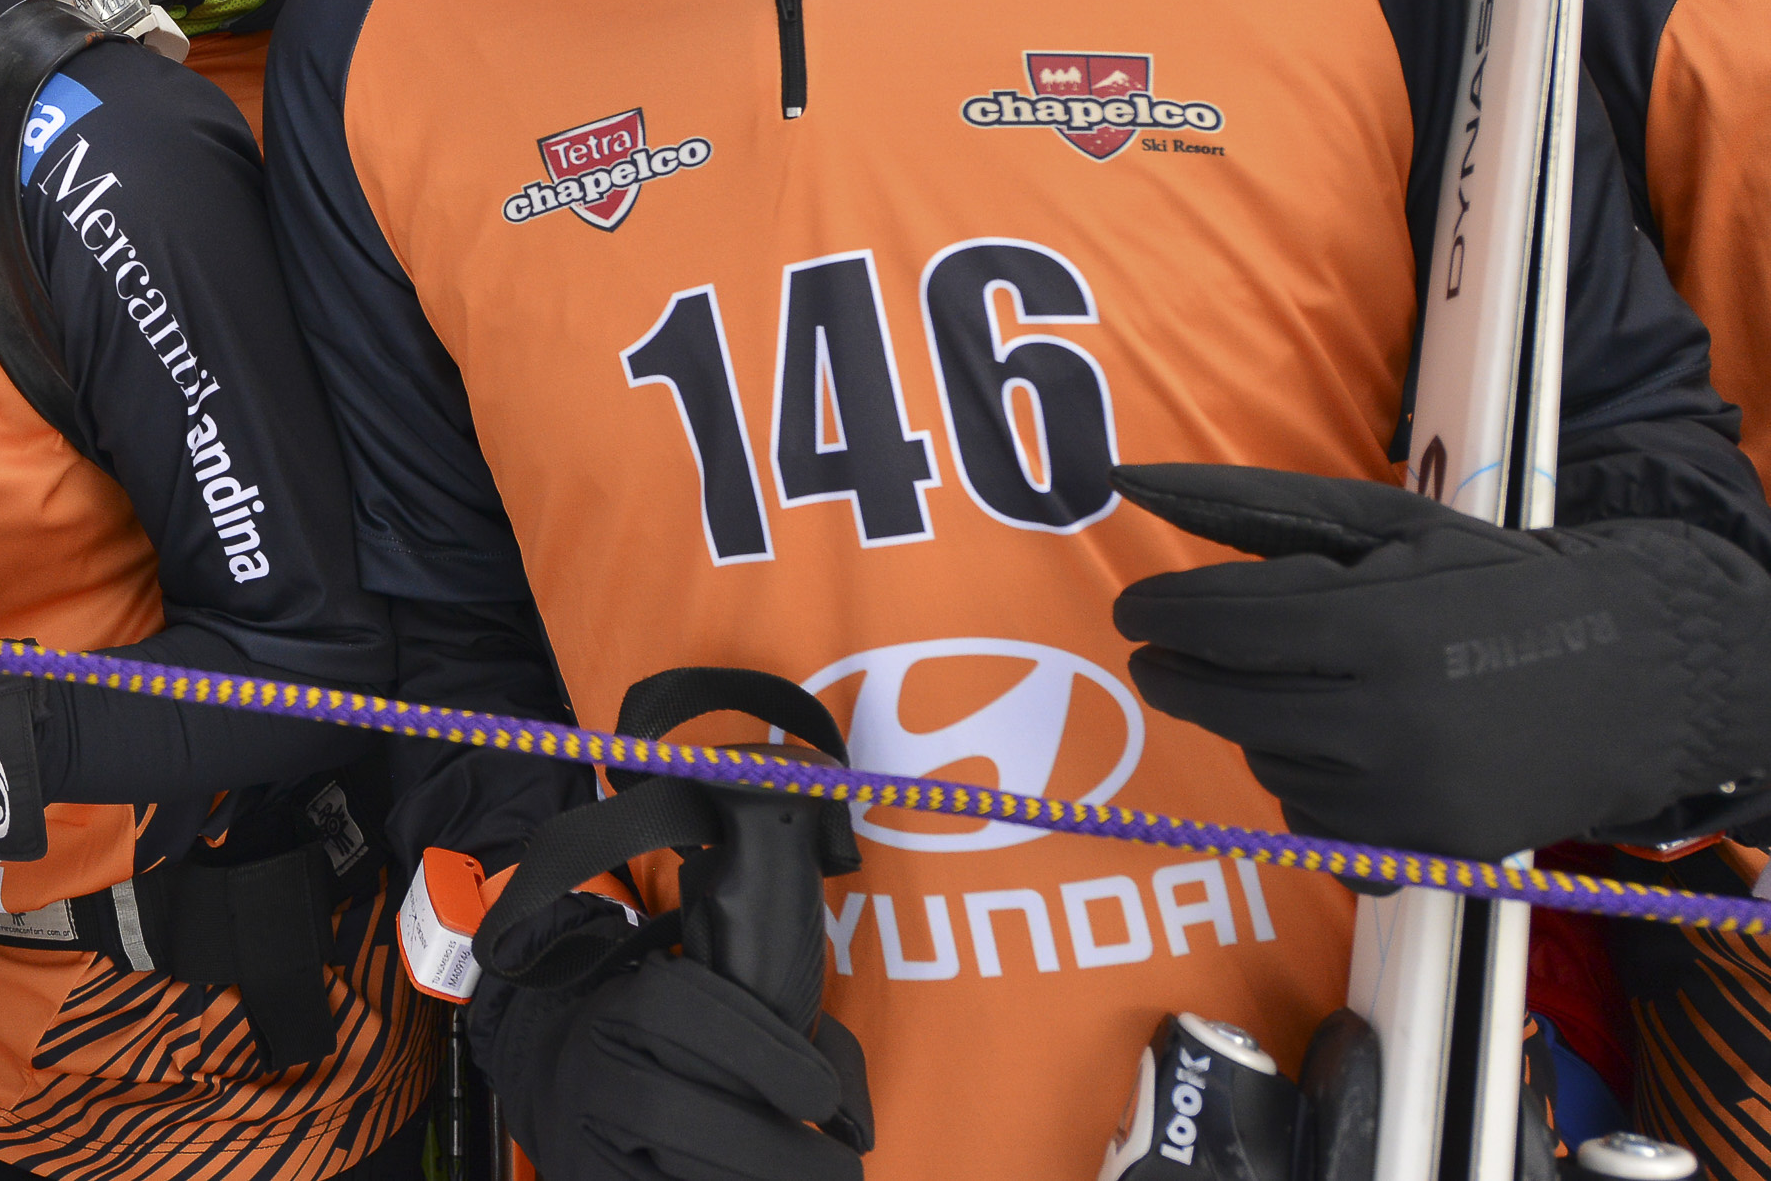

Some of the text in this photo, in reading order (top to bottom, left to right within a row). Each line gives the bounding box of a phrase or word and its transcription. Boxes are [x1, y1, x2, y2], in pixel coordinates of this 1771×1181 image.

[23, 102, 66, 154] a
[550, 130, 632, 169] Tetra
[965, 92, 1221, 130] chapelco
[1141, 138, 1226, 157] Ski Resort
[503, 138, 711, 223] chapelco
[37, 133, 270, 585] Mercantil andina
[619, 237, 1121, 566] 146
[824, 857, 1276, 981] YUNDAI
[1159, 1046, 1212, 1166] LOOK
